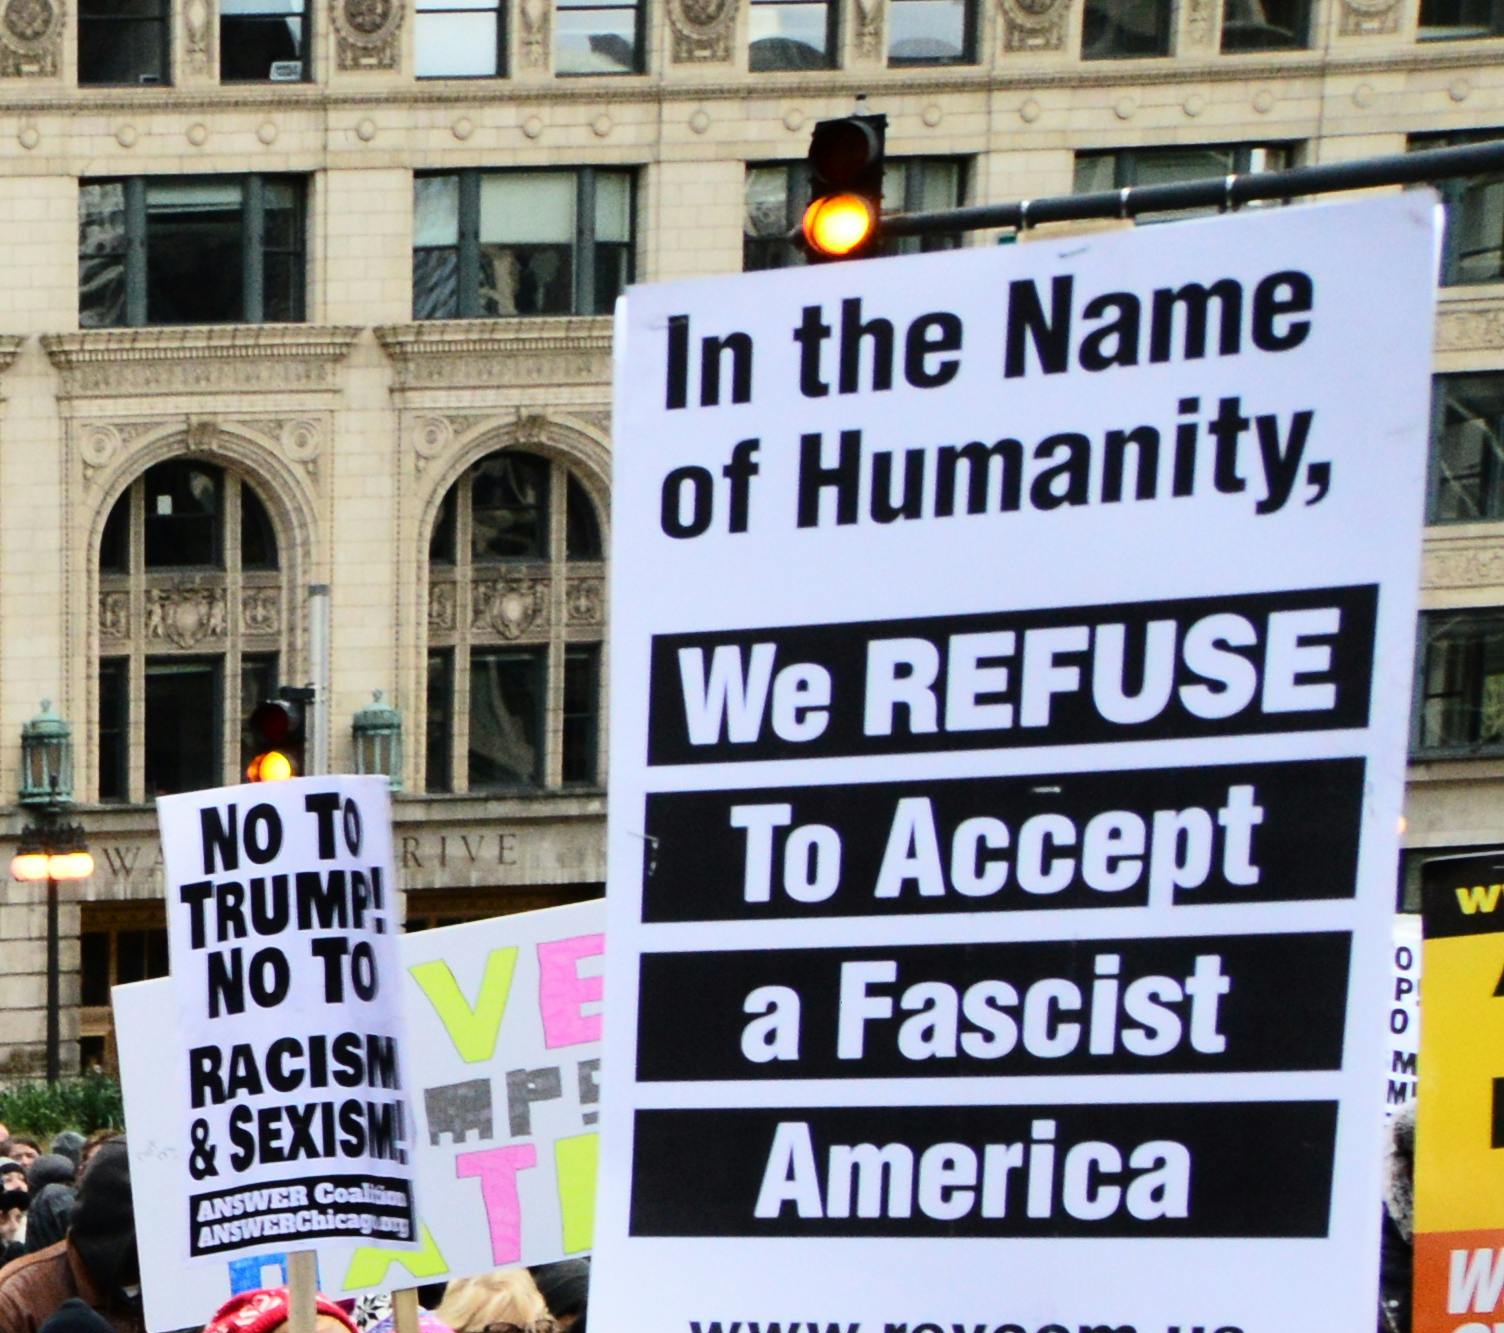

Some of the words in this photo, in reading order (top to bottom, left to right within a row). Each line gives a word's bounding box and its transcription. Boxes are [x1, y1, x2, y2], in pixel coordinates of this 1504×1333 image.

[665, 315, 754, 412] In
[792, 297, 963, 397] the
[1003, 269, 1313, 378] Name
[658, 439, 759, 540] of
[797, 397, 1331, 529] Humanity,
[677, 643, 833, 746] We
[865, 607, 1340, 737] REFUSE
[201, 803, 283, 874] NO
[305, 793, 361, 859] TO
[402, 833, 518, 867] RIVE
[729, 804, 842, 904] To
[875, 787, 1263, 910] Accept
[180, 867, 386, 949] TRUMP!
[207, 946, 289, 1019] NO
[312, 937, 377, 1003] TO
[741, 983, 799, 1062] a
[836, 952, 1230, 1060] Fascist
[189, 1033, 401, 1108] RACISM
[189, 1117, 218, 1180] &
[228, 1100, 408, 1176] SEXISM!
[753, 1120, 1189, 1223] America
[197, 1185, 308, 1222] ANSWER
[313, 1182, 407, 1207] Coalition
